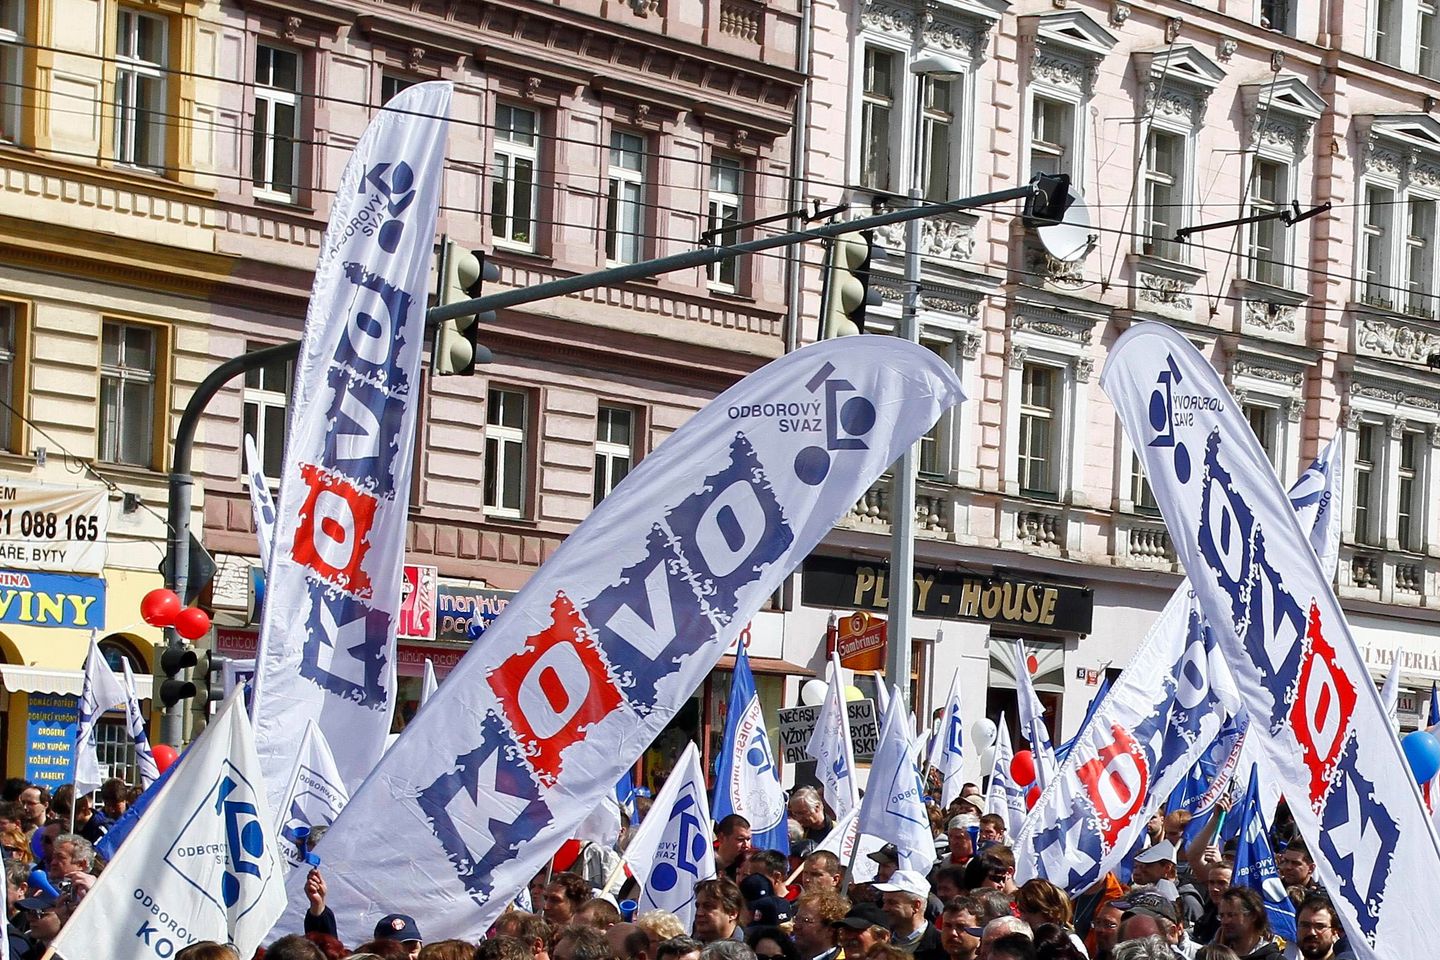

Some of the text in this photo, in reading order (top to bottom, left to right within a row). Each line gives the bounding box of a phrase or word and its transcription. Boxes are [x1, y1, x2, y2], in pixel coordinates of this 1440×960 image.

[728, 401, 822, 421] ODBOROVÝ
[778, 418, 822, 434] SVAZ
[20, 510, 57, 540] 088
[65, 514, 99, 542] 165
[32, 549, 67, 564] BYTY
[853, 566, 935, 613] PLY
[957, 578, 1059, 625] HOUSE
[838, 632, 882, 657] Gambrinus
